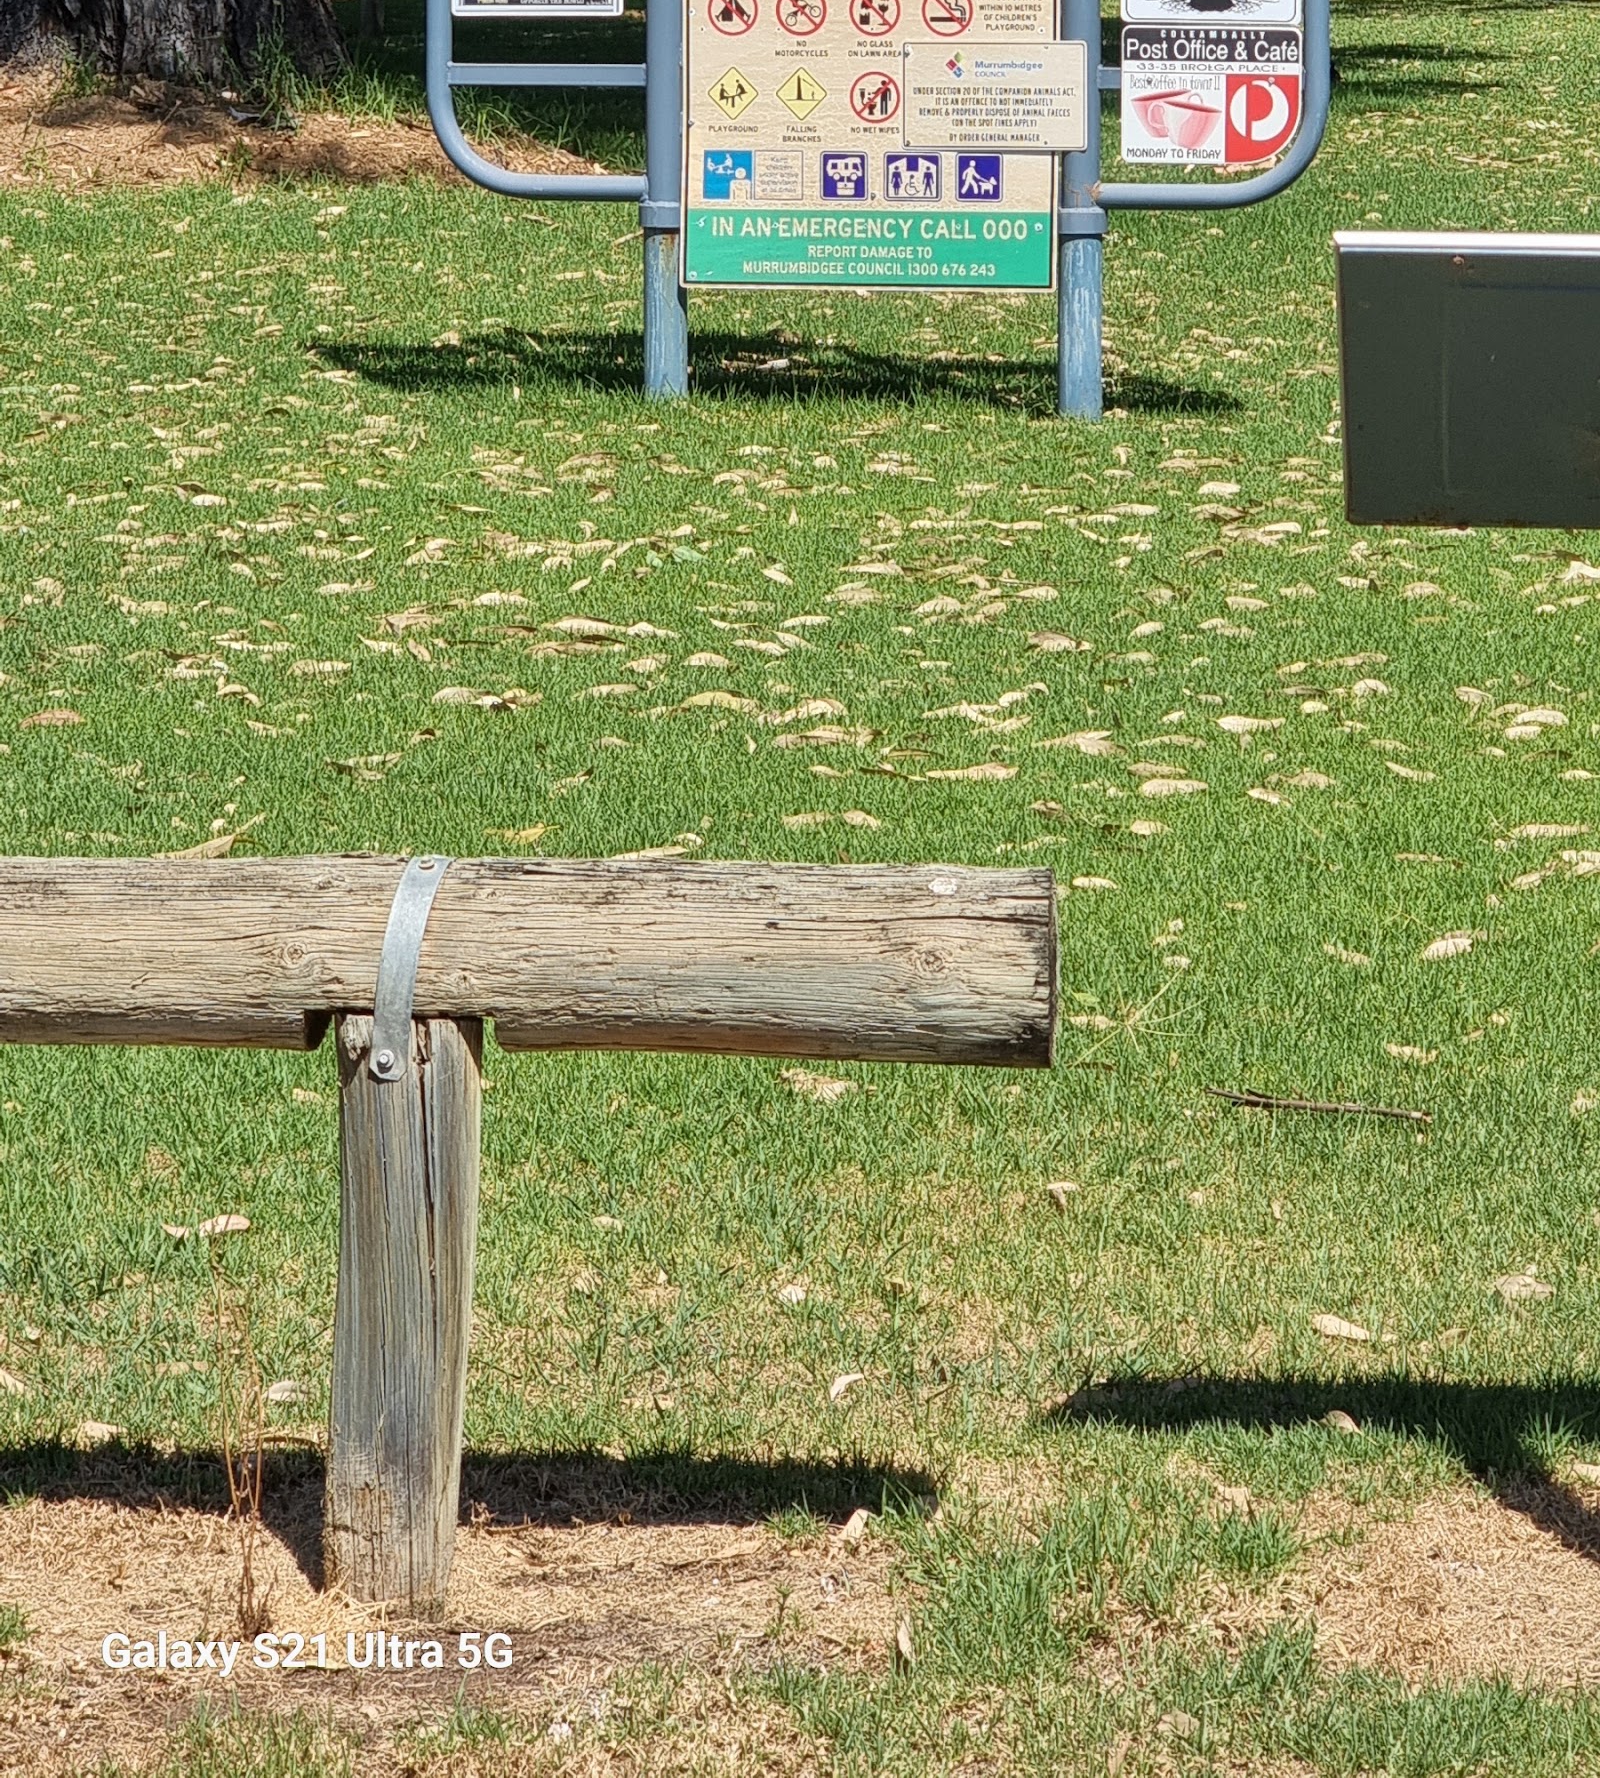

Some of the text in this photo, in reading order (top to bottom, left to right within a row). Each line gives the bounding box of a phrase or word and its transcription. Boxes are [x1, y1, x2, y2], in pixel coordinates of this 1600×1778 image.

[1161, 30, 1265, 39] COLEAMBALLY
[1126, 39, 1297, 61] Post Office & Café
[975, 61, 1043, 71] Murrumbidgee
[913, 87, 933, 95] UNDER
[936, 87, 961, 95] SECTION
[963, 87, 971, 95] 20
[973, 87, 981, 95] OF
[982, 87, 993, 95] THE
[995, 87, 1032, 95] COMPANION
[1126, 148, 1222, 159] MONDAY TO FRIDAY
[712, 219, 733, 237] IN
[740, 219, 771, 237] AN
[778, 218, 913, 239] EMERGENCY
[920, 218, 977, 240] CALL
[808, 246, 932, 258] REPORT DAMAGE TO
[743, 261, 995, 277] MURRUMBIDGEE COUNCIL 1300 676 243
